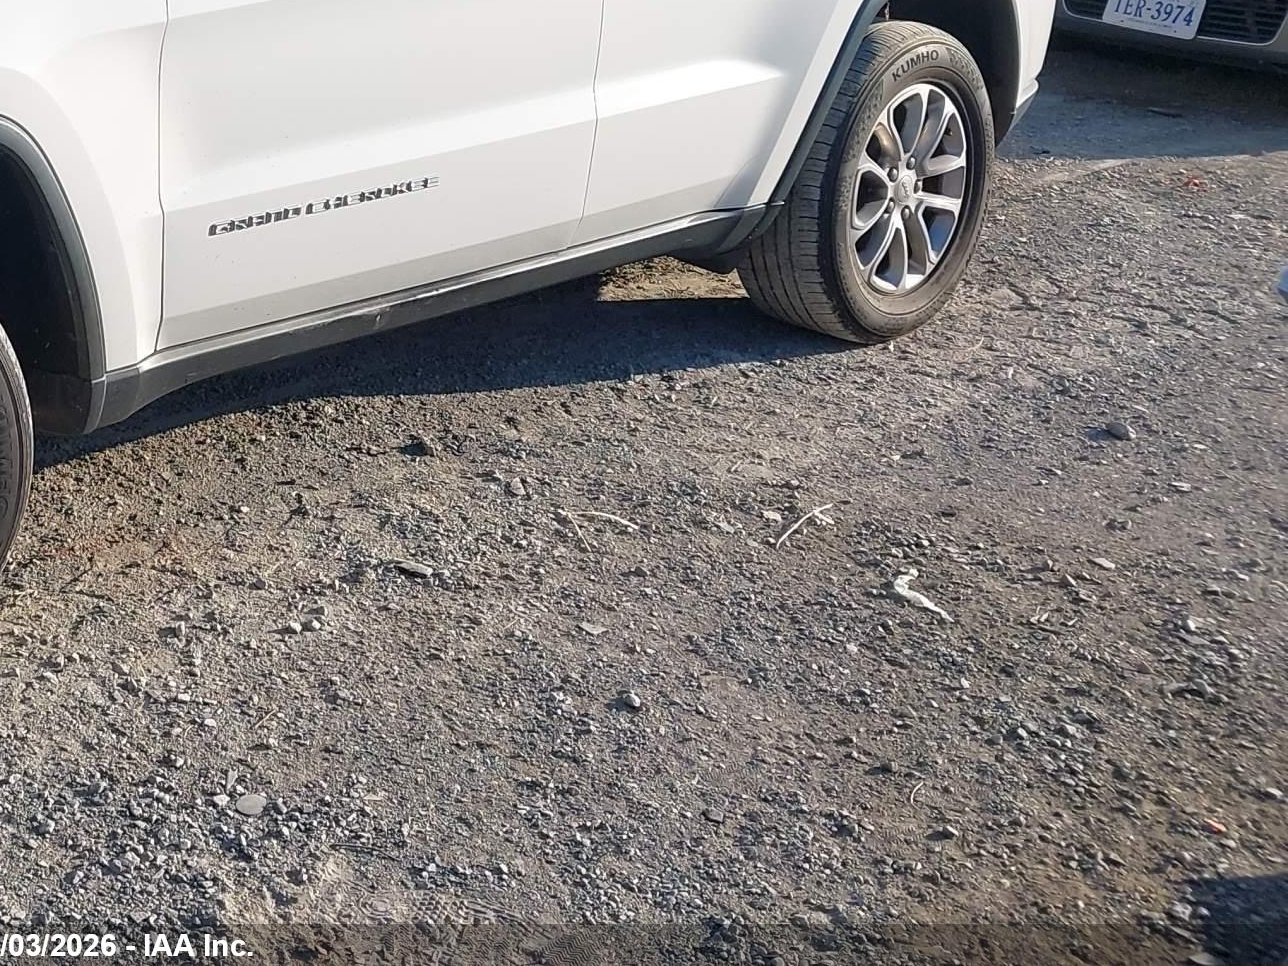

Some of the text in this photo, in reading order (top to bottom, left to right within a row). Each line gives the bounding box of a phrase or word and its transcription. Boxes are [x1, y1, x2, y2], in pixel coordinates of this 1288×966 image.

[892, 49, 939, 82] KUMHO
[208, 176, 440, 236] GRAND CHEROKEE
